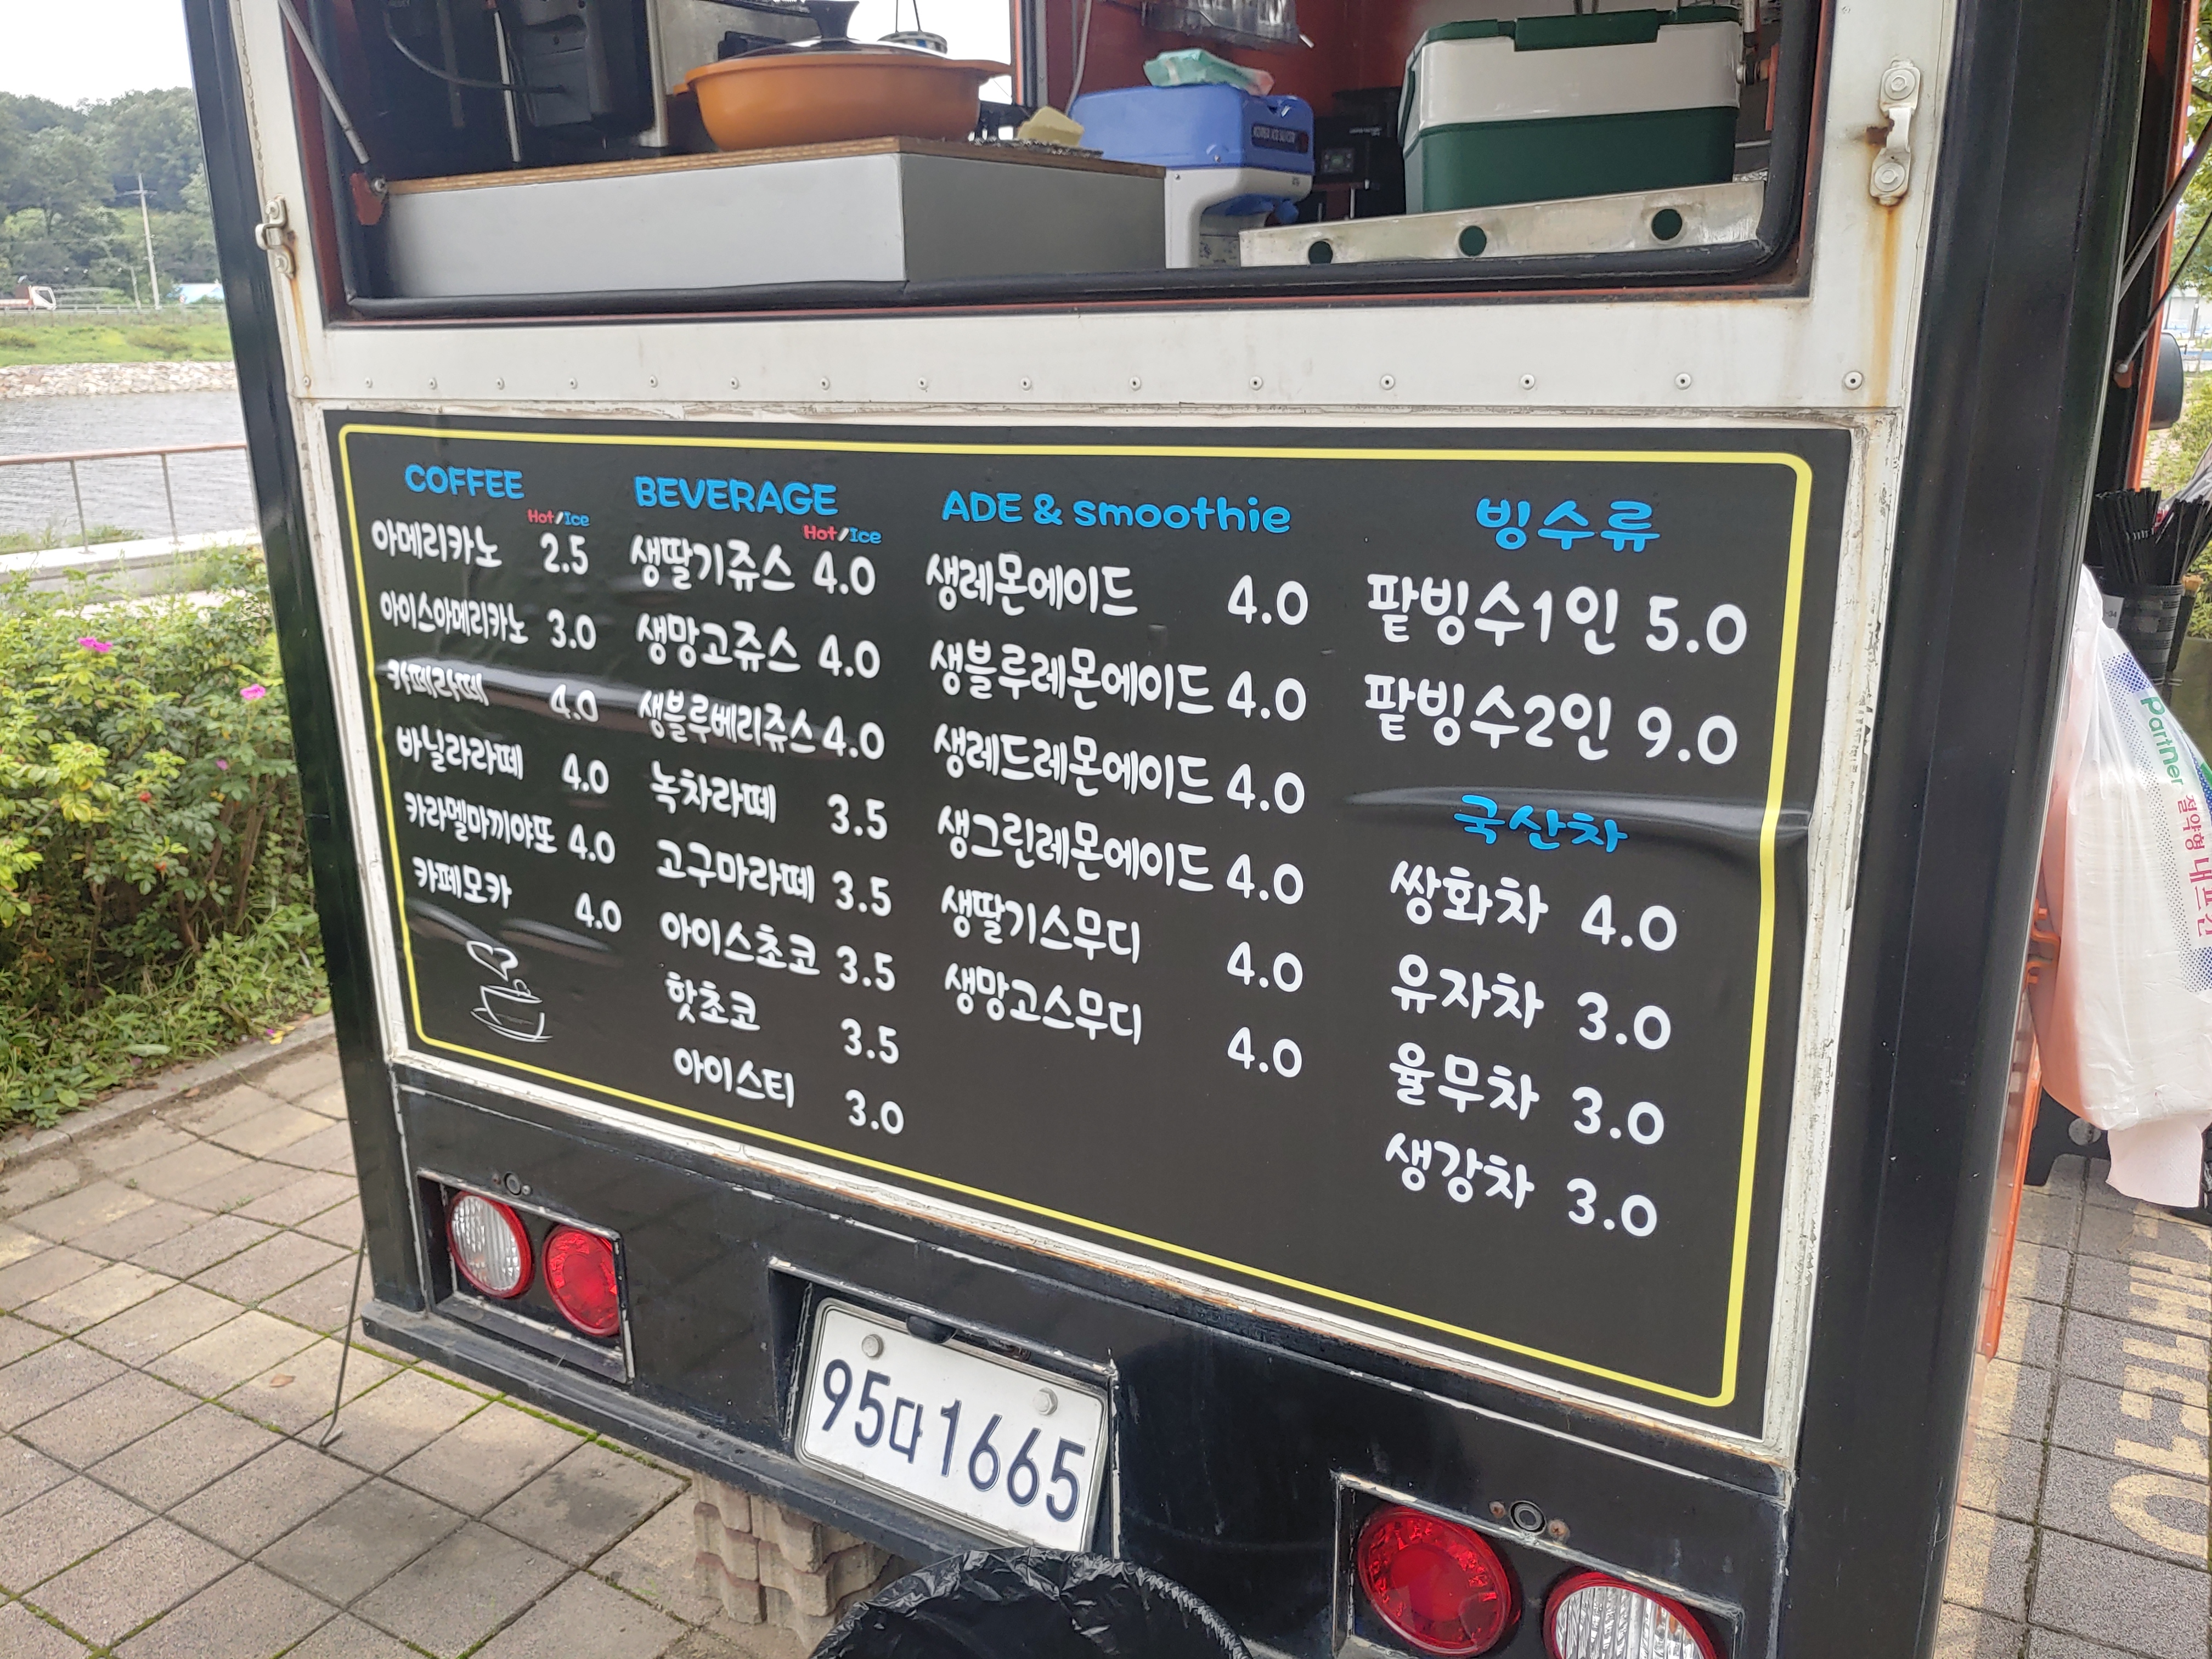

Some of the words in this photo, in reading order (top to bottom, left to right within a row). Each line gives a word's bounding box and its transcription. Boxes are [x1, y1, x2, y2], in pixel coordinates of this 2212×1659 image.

[404, 464, 524, 500] COFFEE
[633, 475, 839, 516] BEVERAGE
[941, 489, 1023, 523] ADE
[1033, 493, 1063, 526] &
[1073, 496, 1291, 534] smoothie
[371, 518, 503, 568] 아메리카노
[540, 532, 589, 575] 2.5
[1476, 497, 1661, 552] 빙수류
[629, 534, 796, 593] 생딸기쥬스
[813, 551, 876, 596] 4.0
[926, 552, 1138, 617] 생레몬에이드
[1227, 574, 1308, 625] 4.0
[380, 590, 529, 644] 아이스아메리카노
[547, 608, 596, 650] 3.0
[637, 613, 801, 673] 생망고쥬스
[819, 634, 881, 679] 4.0
[1367, 573, 1618, 655] 팥빙수1인
[1645, 595, 1747, 655] 5.0
[386, 659, 489, 707] 카페라떼
[550, 684, 599, 723] 4.0
[930, 639, 1214, 714] 생블루레몬에이드
[1227, 670, 1306, 721] 4.0
[638, 689, 816, 755] 생블루베리쥬스
[821, 715, 887, 760] 4.0
[1364, 674, 1612, 761] 팥빙수2인
[1638, 706, 1737, 765] 9.0
[2140, 696, 2184, 786] Partner
[396, 724, 523, 780] 바닐라라떼
[562, 753, 609, 794] 4.0
[934, 723, 1214, 804] 생레드레몬에이드
[1227, 763, 1305, 814] 4.0
[404, 792, 557, 854] 카라멜마끼야또
[568, 823, 616, 864] 4.0
[651, 760, 776, 823] 녹차라떼
[827, 793, 888, 840] 3.5
[1454, 794, 1628, 853] 국산차
[2177, 794, 2205, 851] 절약형
[413, 856, 512, 909] 카페모카
[575, 893, 622, 932] 4.0
[657, 839, 815, 904] 고구마라떼
[832, 870, 891, 917] 3.5
[938, 805, 1214, 892] 생그린레몬에이드
[1226, 854, 1304, 905] 4.0
[941, 884, 1140, 964] 생딸기스무디
[1227, 941, 1303, 992] 4.0
[1390, 860, 1549, 934] 쌍화차
[1581, 894, 1678, 951] 4.0
[660, 912, 820, 975] 아이스초코
[836, 945, 895, 991] 3.5
[665, 971, 760, 1031] 핫초코
[840, 1018, 899, 1064] 3.5
[945, 963, 1142, 1045] 생망고스무디
[1227, 1026, 1302, 1078] 4.0
[1391, 954, 1545, 1029] 유자차
[1577, 991, 1671, 1050] 3.0
[673, 1048, 794, 1108] 아이스티
[845, 1089, 904, 1135] 3.0
[1389, 1042, 1540, 1120] 율무차
[1572, 1086, 1664, 1145] 3.0
[1385, 1132, 1535, 1209] 생강차
[1566, 1178, 1657, 1237] 3.0
